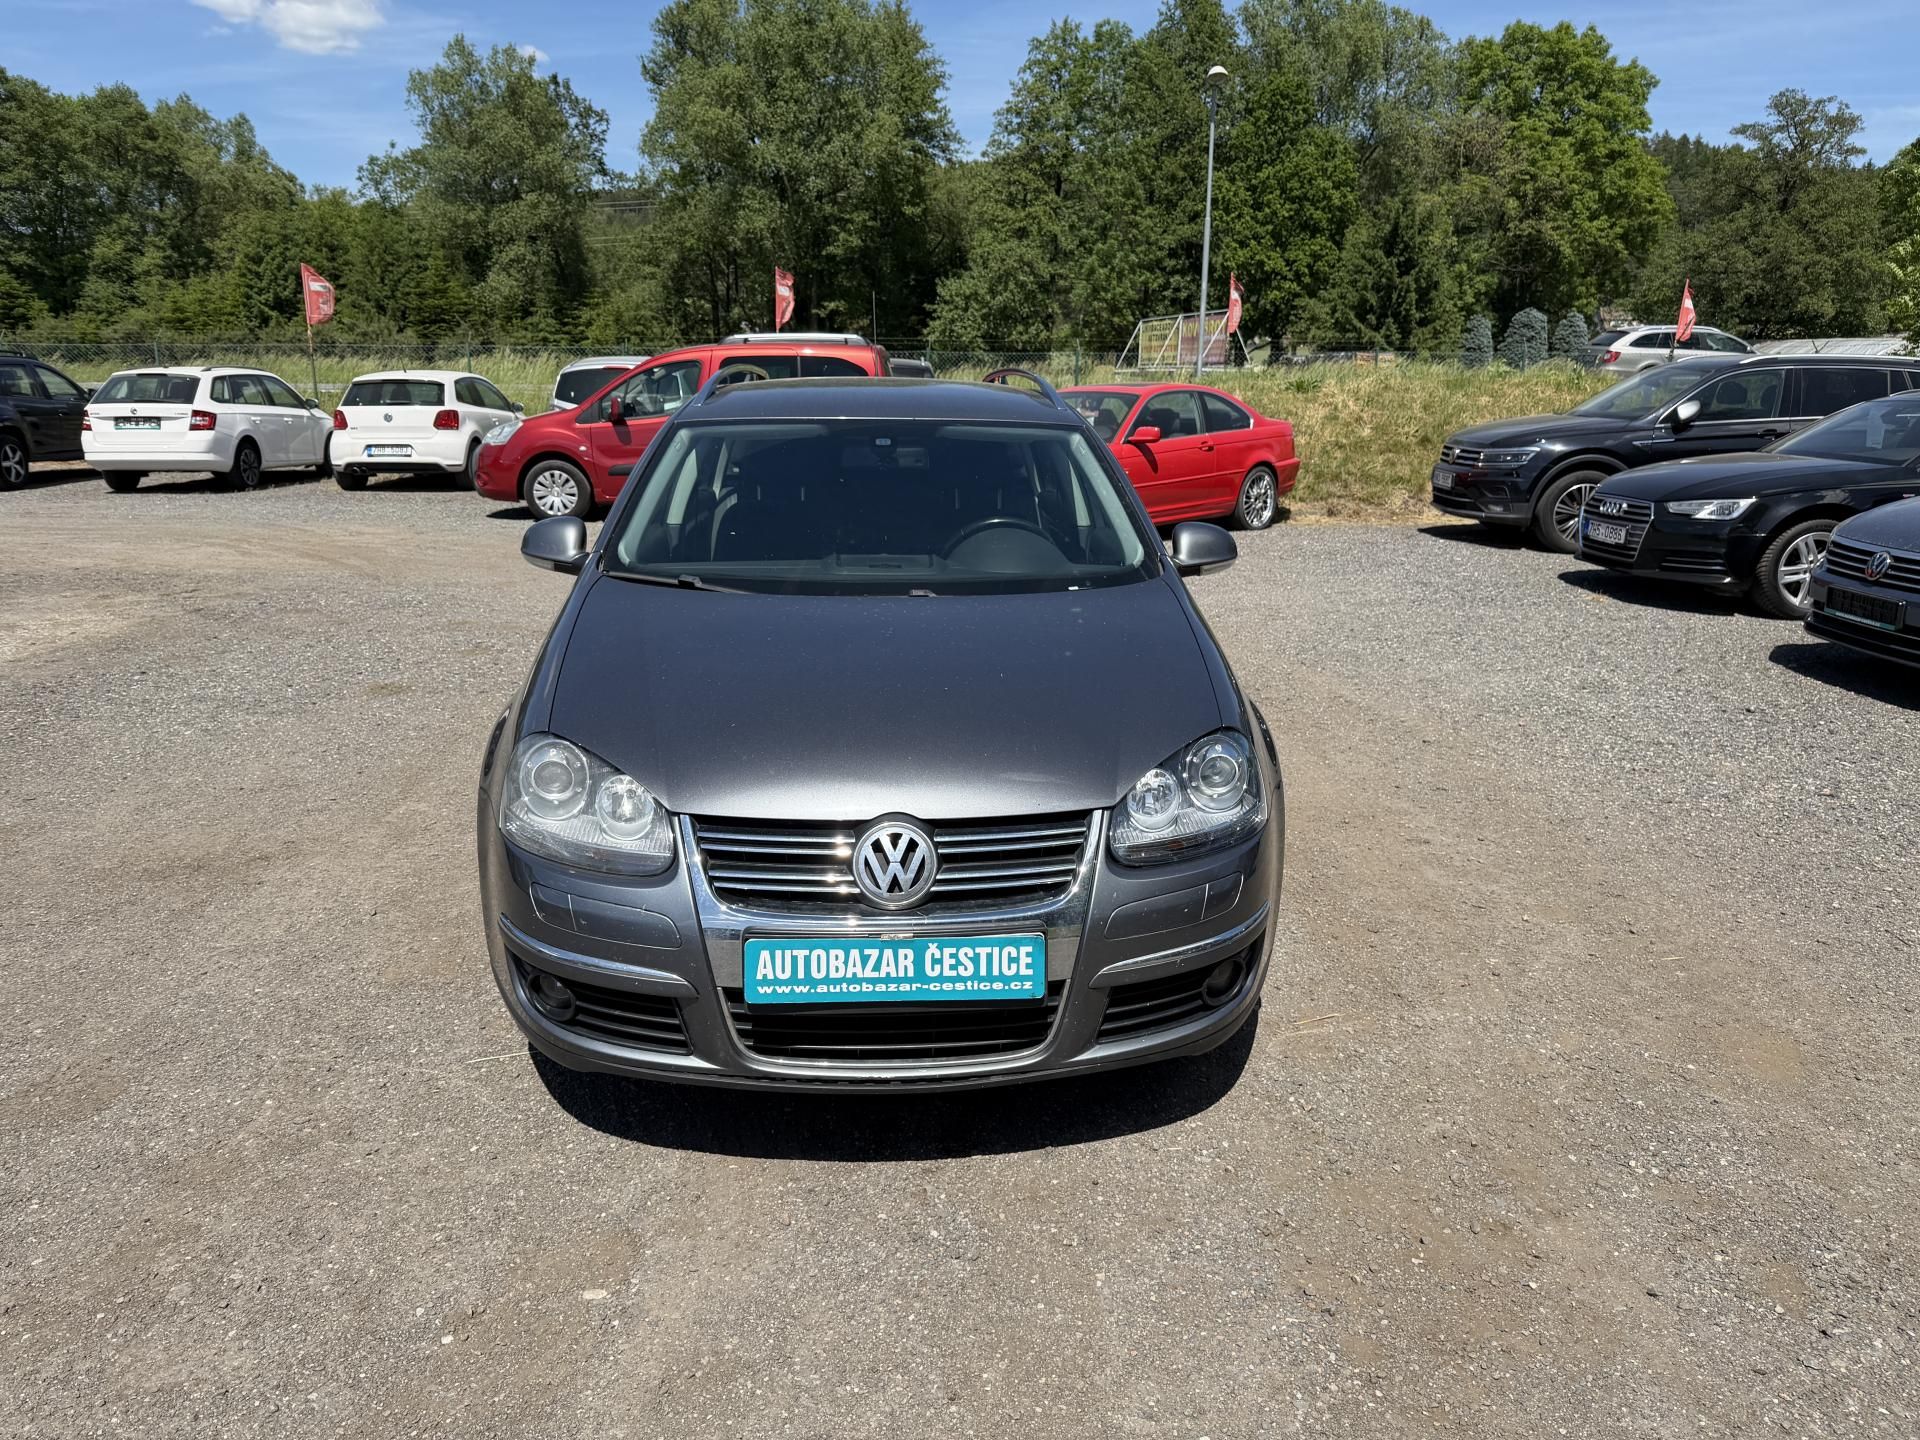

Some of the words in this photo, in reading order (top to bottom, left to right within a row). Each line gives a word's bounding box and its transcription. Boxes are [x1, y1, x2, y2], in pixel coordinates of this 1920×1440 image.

[857, 826, 932, 900] VW
[756, 948, 914, 980] AUTOBAZAR
[924, 943, 1033, 977] ČESTICE
[757, 981, 1033, 994] www.autobazar-cestice.cz
